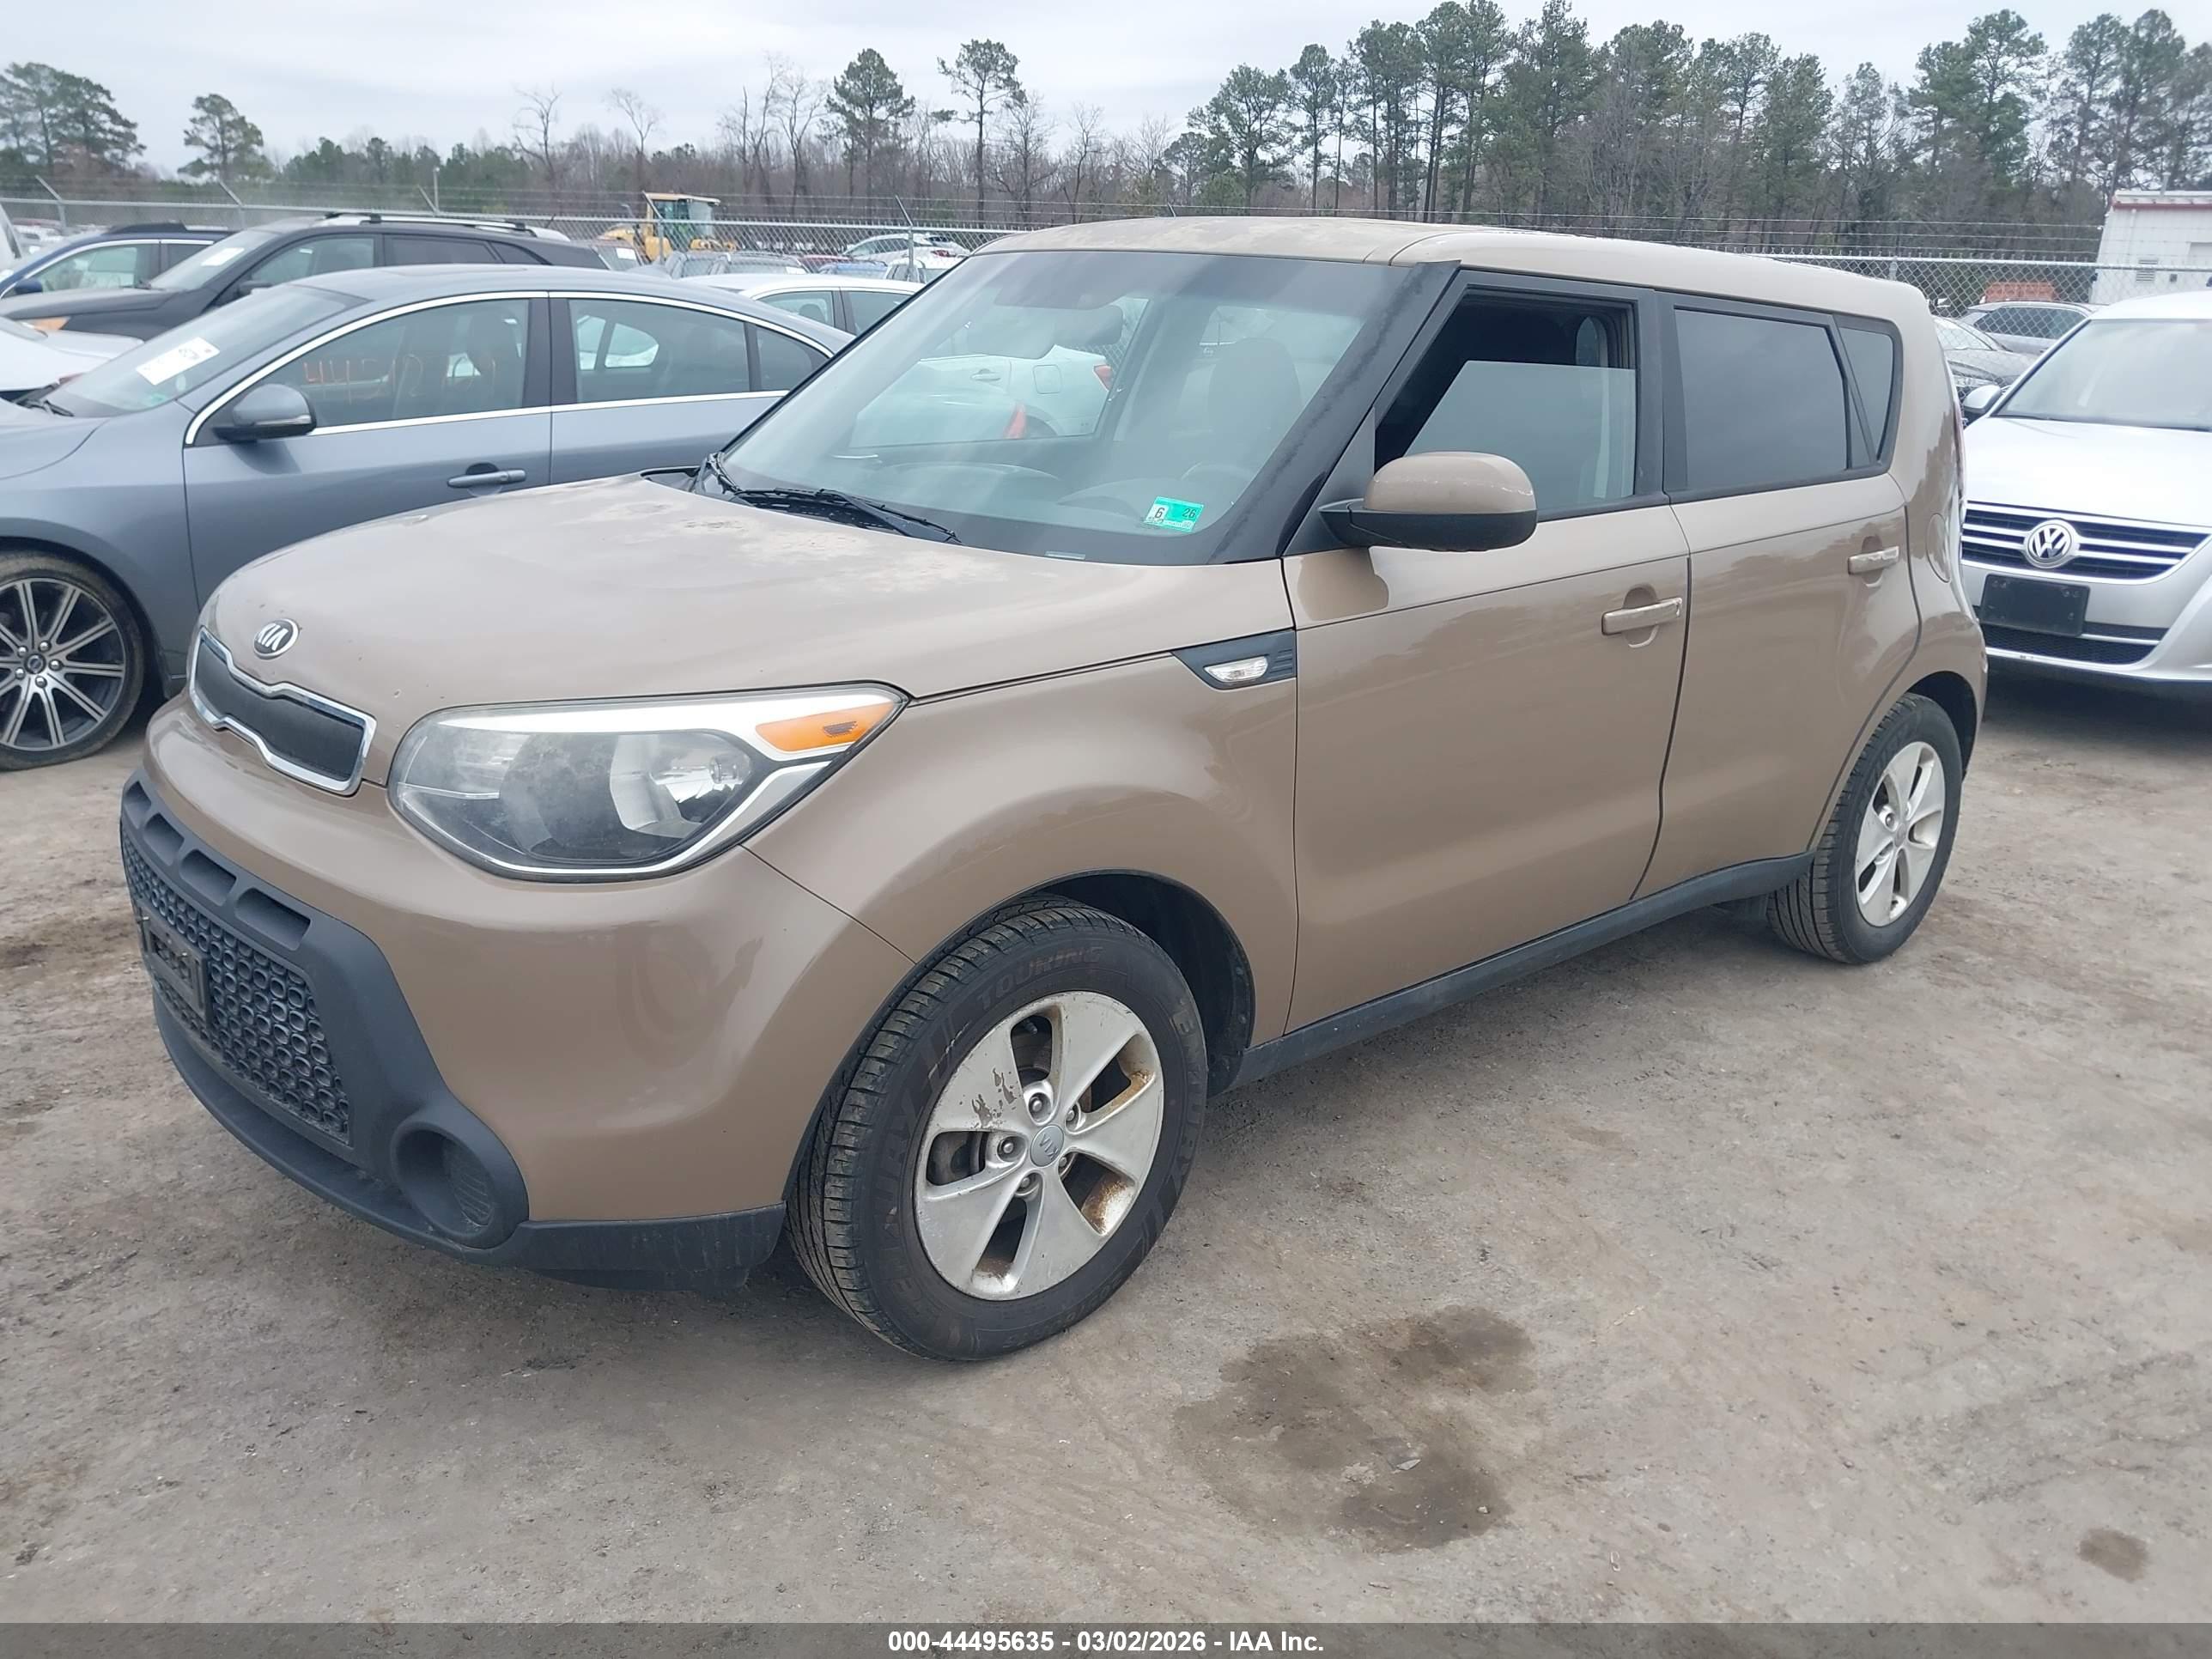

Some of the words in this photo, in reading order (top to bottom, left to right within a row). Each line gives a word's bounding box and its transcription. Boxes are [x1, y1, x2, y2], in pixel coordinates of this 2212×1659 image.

[1154, 507, 1166, 519] 6
[1182, 507, 1197, 519] 26
[257, 623, 289, 651] KIA
[1039, 1132, 1059, 1161] KIA
